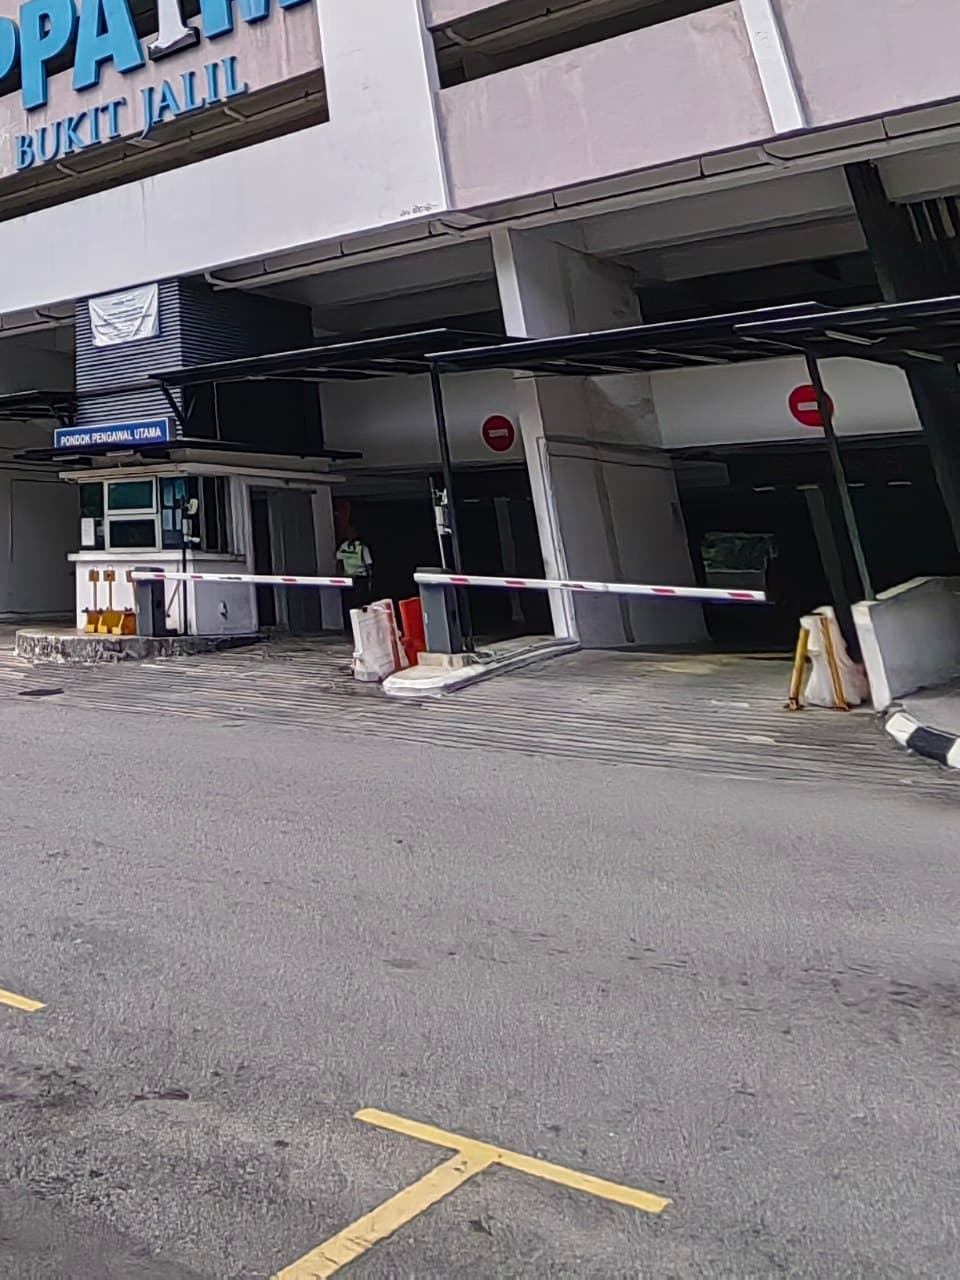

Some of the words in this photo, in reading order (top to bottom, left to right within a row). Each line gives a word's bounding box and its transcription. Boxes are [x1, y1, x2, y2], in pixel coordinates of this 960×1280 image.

[14, 96, 127, 171] BUKIT
[140, 56, 249, 139] JALIL
[60, 433, 91, 447] PONDOK
[92, 430, 133, 444] PENGAWAL
[134, 426, 162, 439] UTAMA
